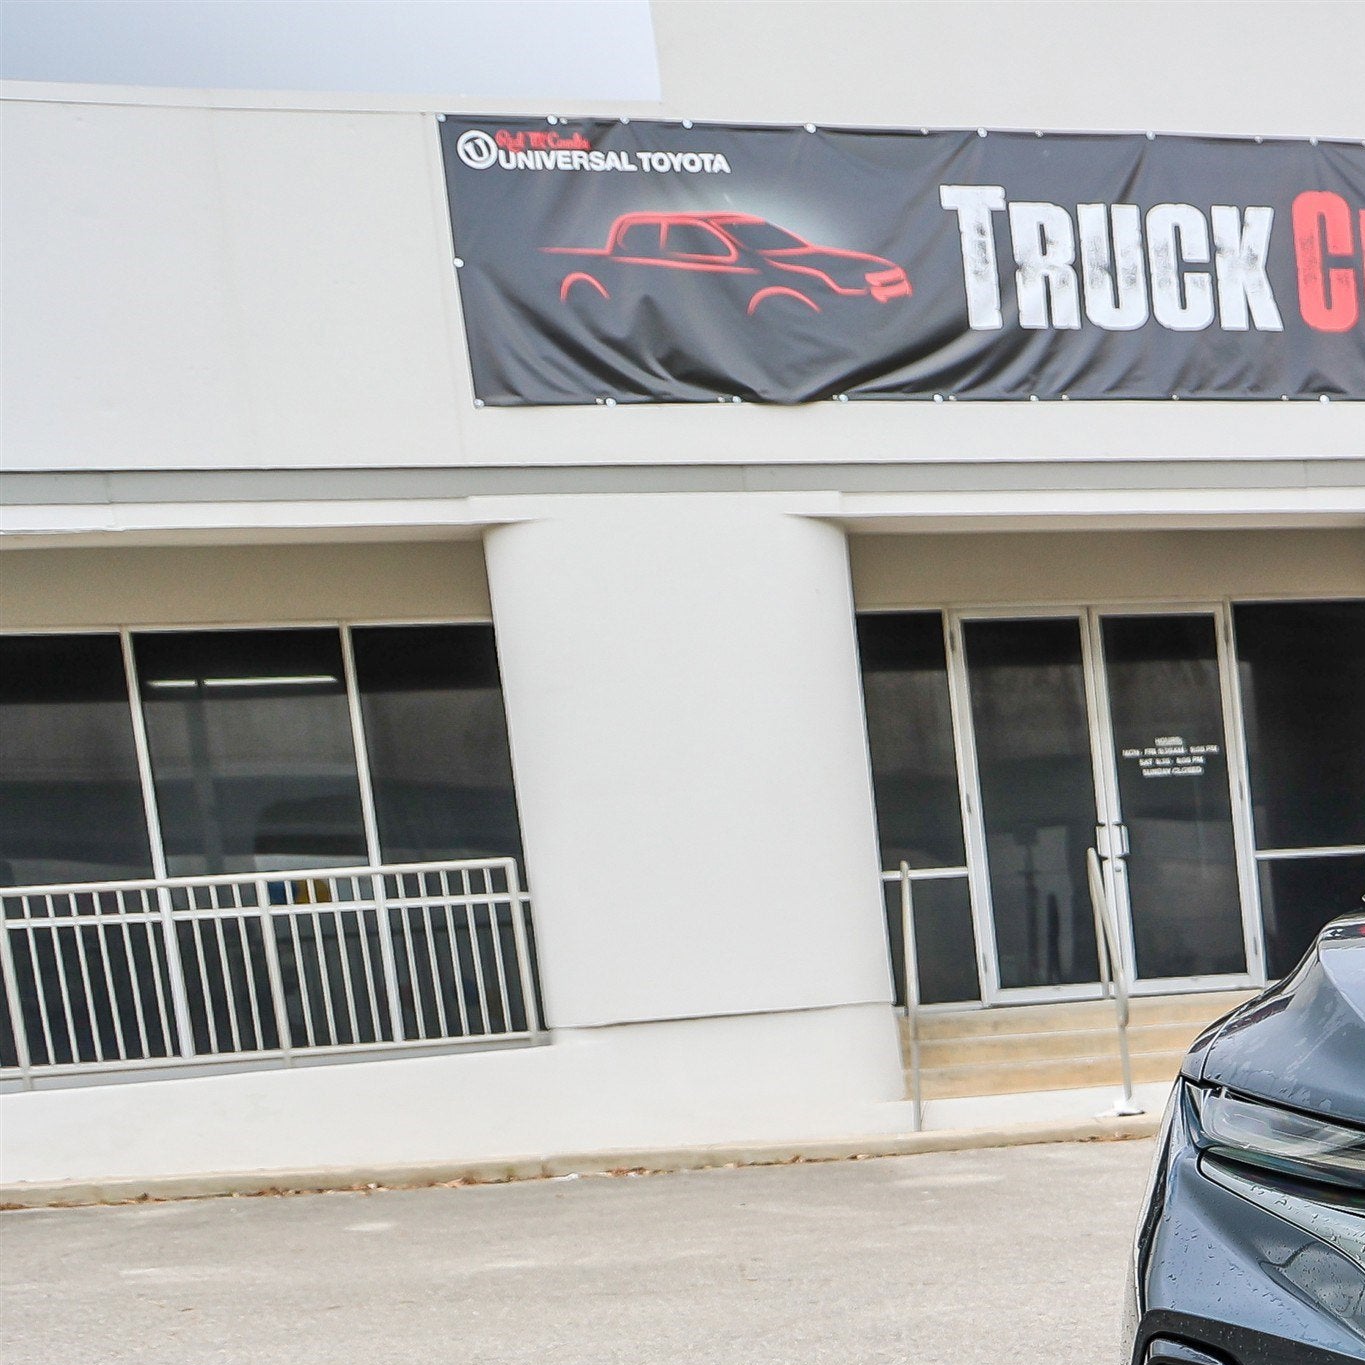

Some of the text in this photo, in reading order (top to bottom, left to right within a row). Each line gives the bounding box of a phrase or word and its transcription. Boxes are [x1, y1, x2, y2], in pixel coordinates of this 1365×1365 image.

[498, 150, 731, 174] UNIVERSAL TOYOTA
[939, 184, 1284, 332] TRUCK
